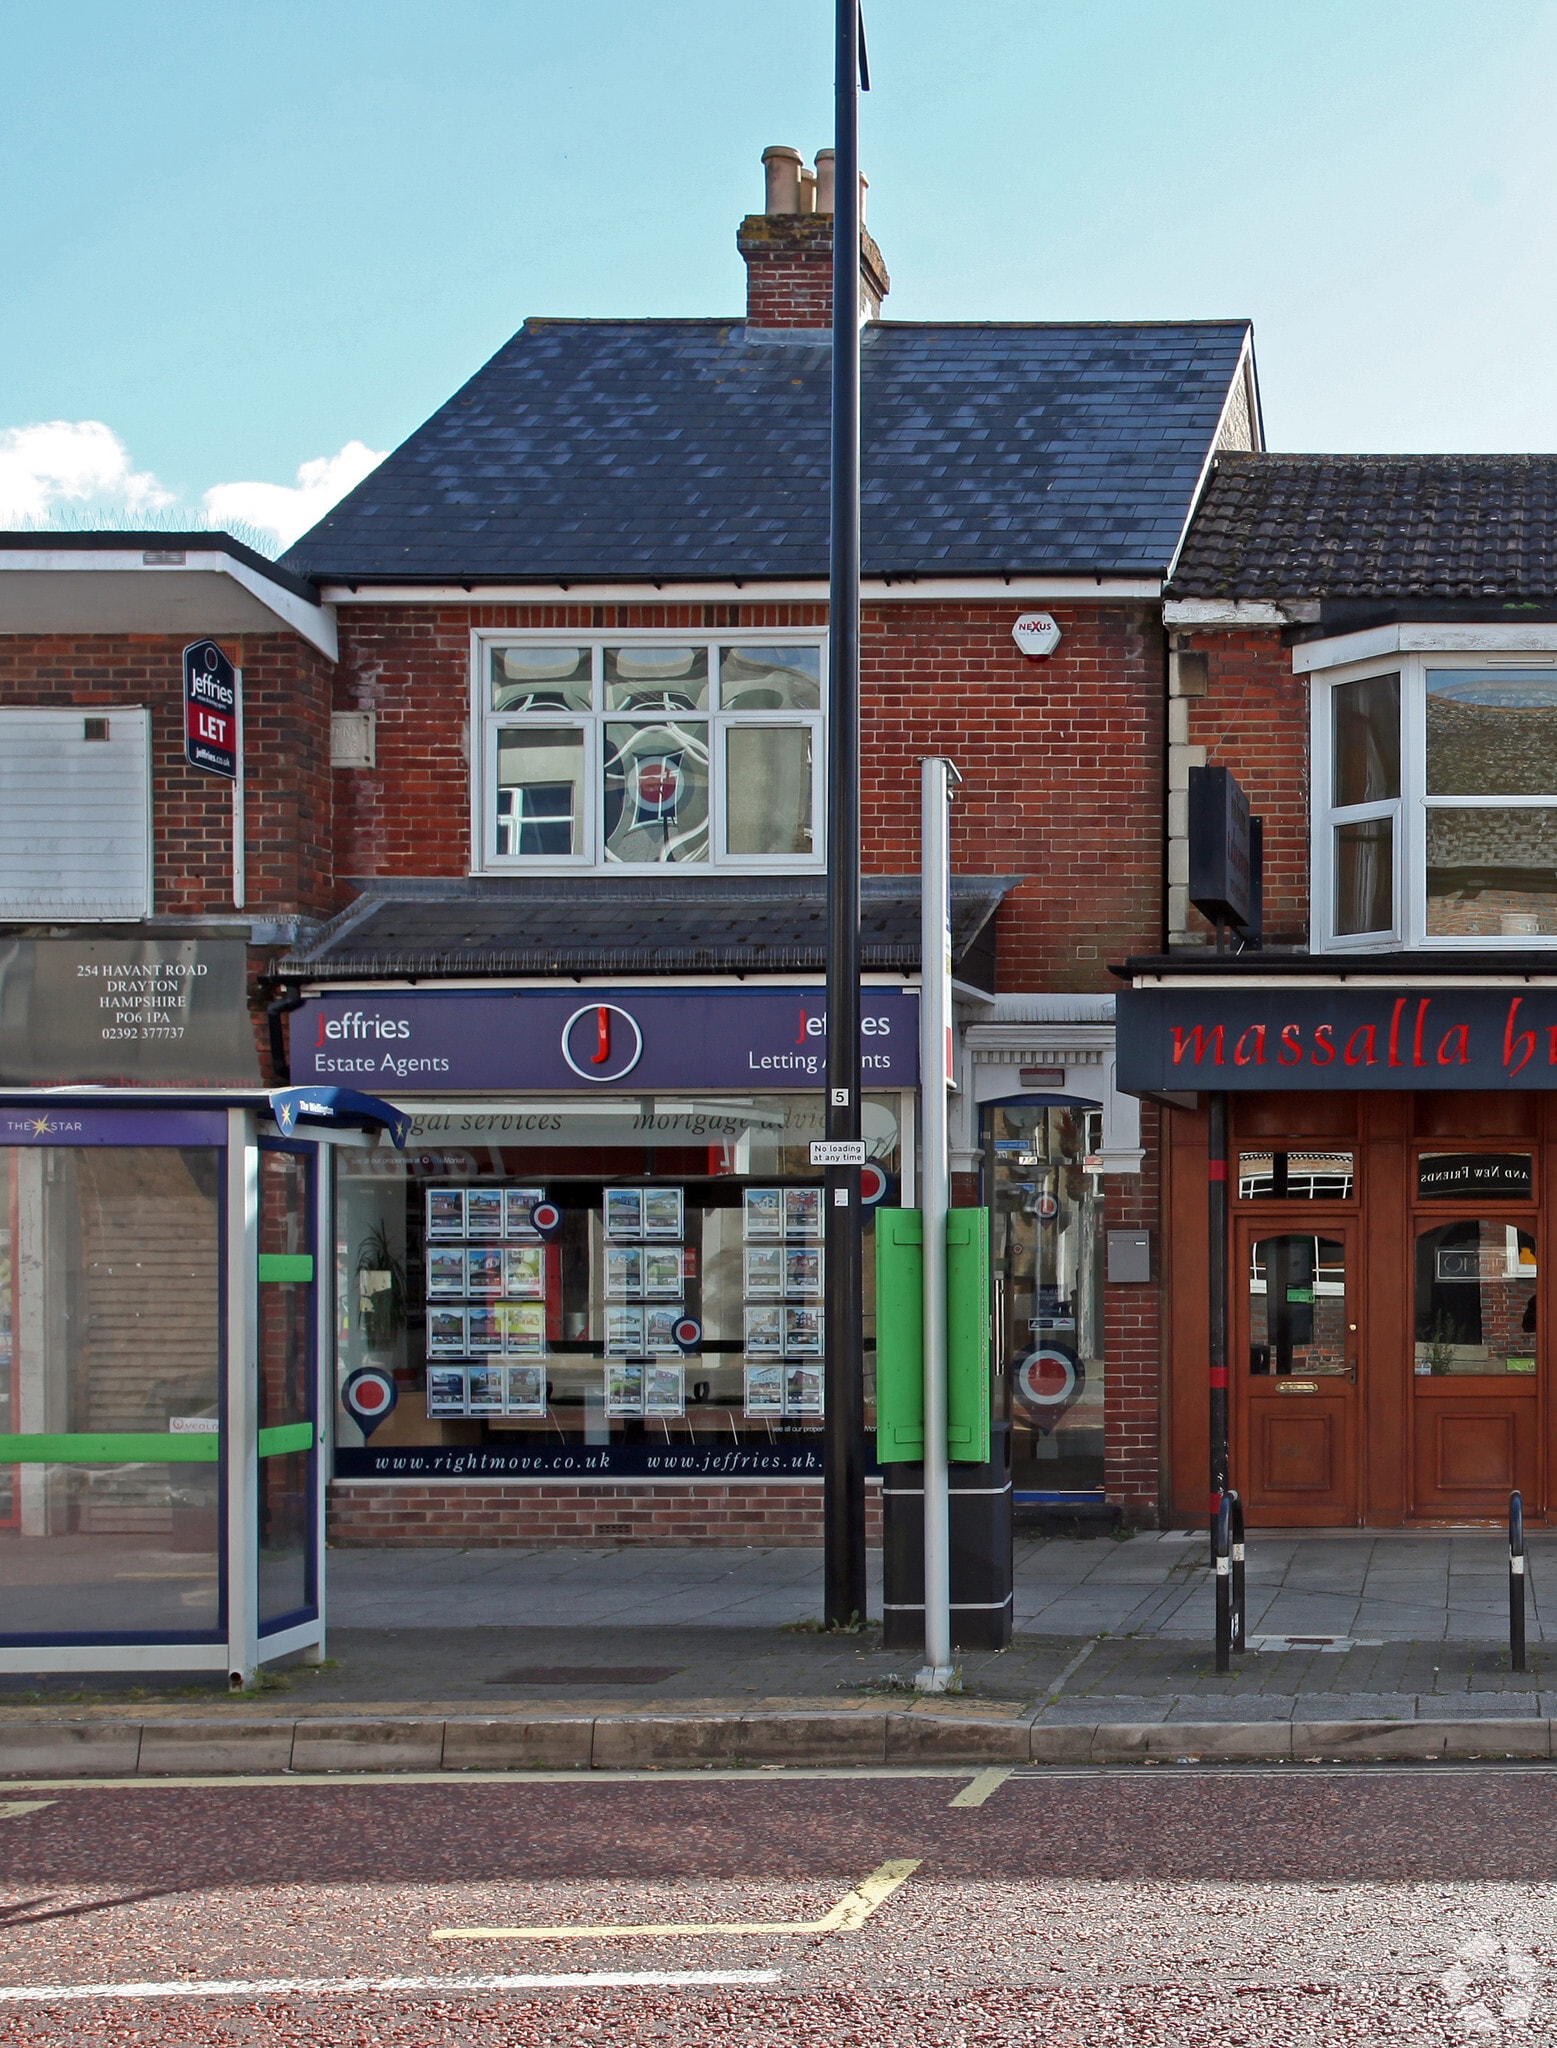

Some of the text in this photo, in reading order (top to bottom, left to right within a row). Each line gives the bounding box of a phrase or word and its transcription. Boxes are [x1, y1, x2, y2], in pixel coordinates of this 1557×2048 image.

[1018, 621, 1052, 633] NEXUS
[191, 668, 233, 705] Jeffries
[199, 711, 226, 743] LET
[77, 964, 208, 977] 254 HAVANT ROAD
[107, 980, 178, 992] DRAYTON
[100, 996, 186, 1008] HAMPSHIRE
[116, 1011, 171, 1024] PO6 1PA
[102, 1027, 185, 1040] 02392 377737
[314, 1011, 410, 1047] Jeffries
[1169, 998, 1471, 1067] massalla
[315, 1053, 450, 1077] Estate Agents
[749, 1051, 818, 1074] Letting
[835, 1091, 845, 1103] 5
[8, 1122, 82, 1131] THE STAR
[410, 1114, 562, 1136] gal services
[633, 1113, 749, 1135] mortgage
[830, 1145, 861, 1154] loading
[825, 1155, 840, 1163] any
[375, 1453, 610, 1472] www.rightmove.co.uk
